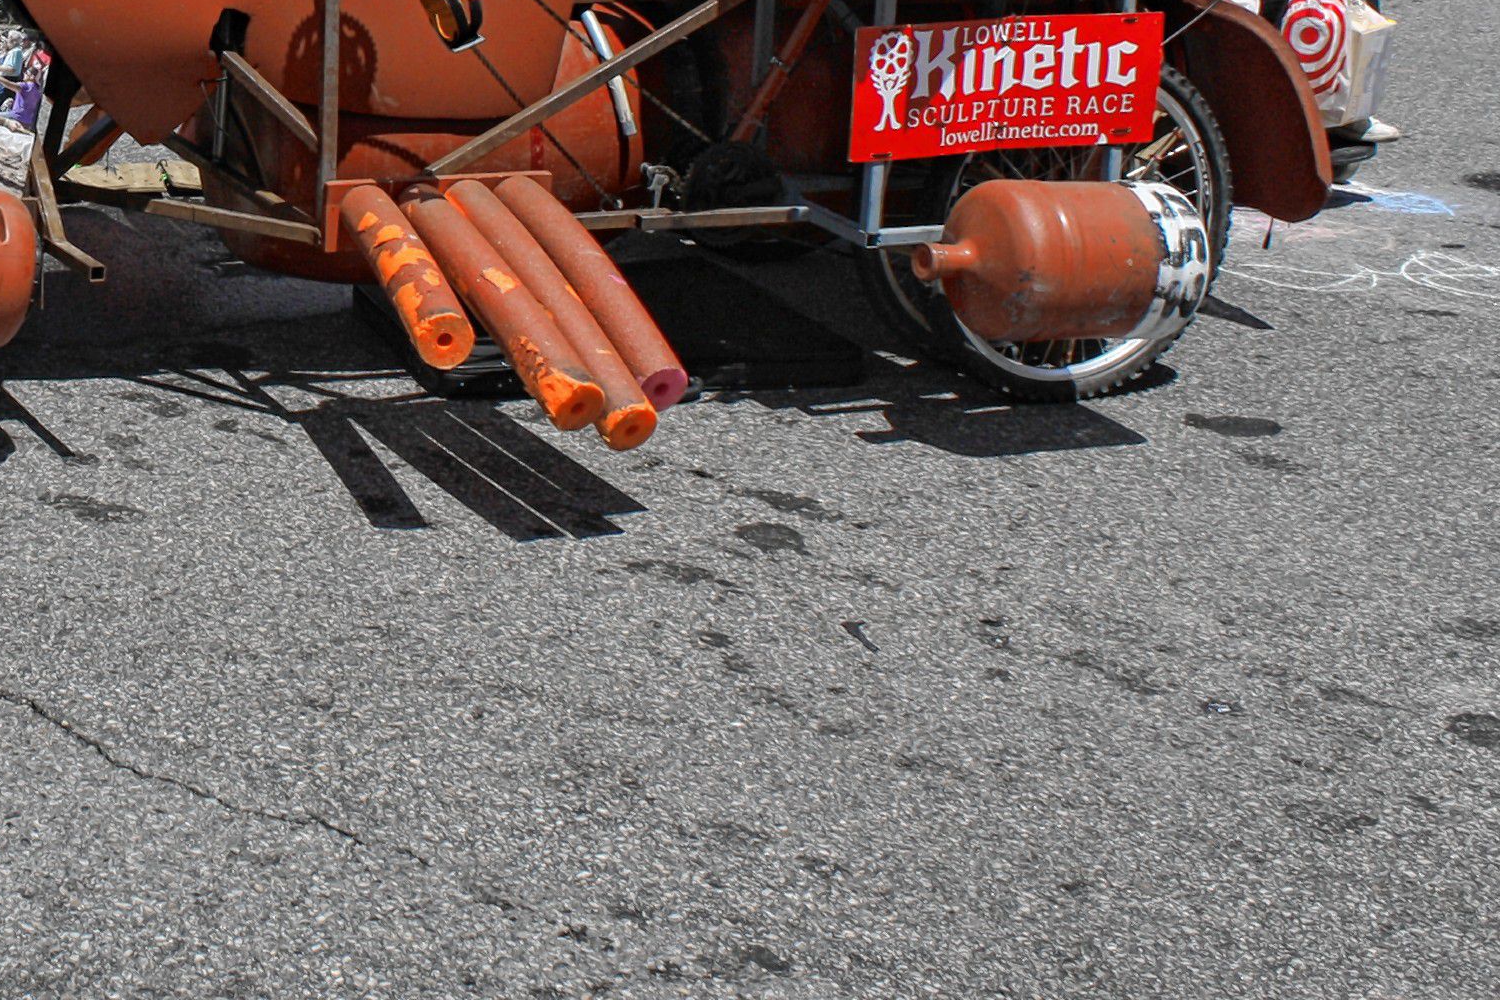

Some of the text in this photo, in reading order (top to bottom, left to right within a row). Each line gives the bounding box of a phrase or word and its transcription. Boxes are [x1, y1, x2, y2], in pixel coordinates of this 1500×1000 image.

[961, 21, 1057, 47] LOWELL
[909, 25, 1140, 101] Kinetic
[905, 93, 1136, 129] SCULPTURE RACE
